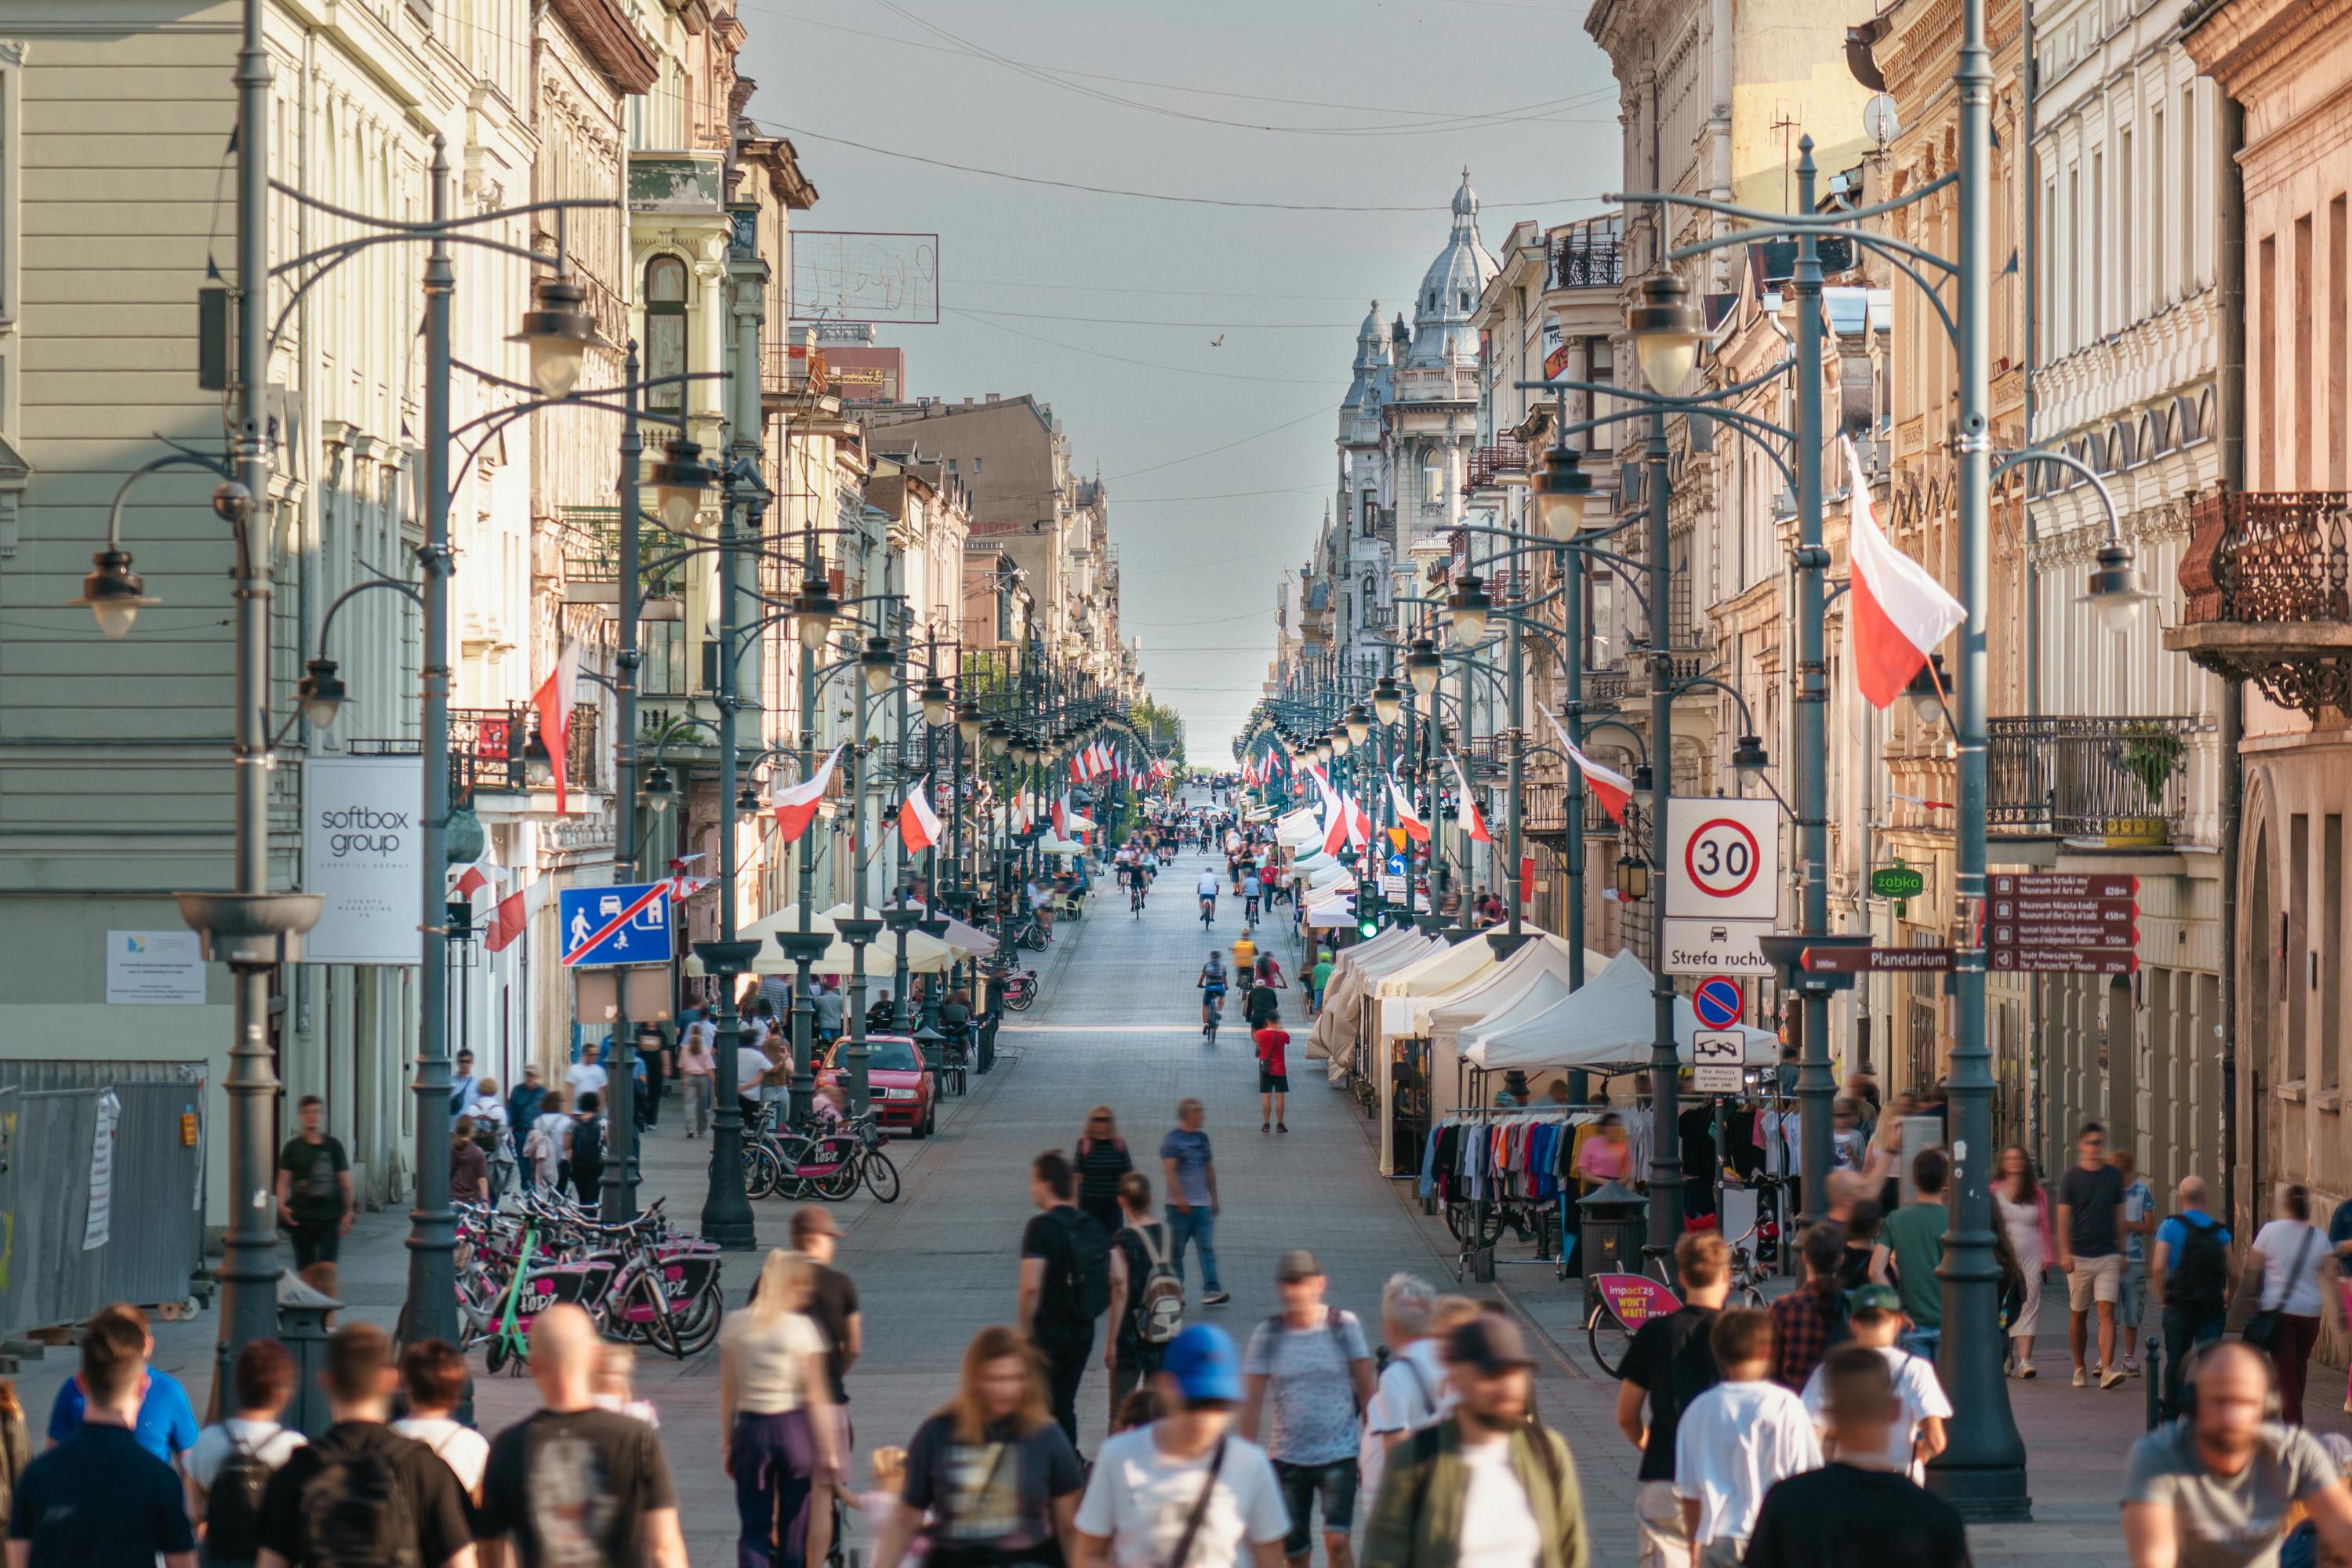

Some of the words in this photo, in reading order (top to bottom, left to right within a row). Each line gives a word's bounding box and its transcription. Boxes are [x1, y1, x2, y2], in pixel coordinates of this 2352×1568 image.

[321, 805, 408, 829] softbox
[331, 833, 400, 858] group
[1697, 840, 1748, 877] 30
[1878, 875, 1919, 888] żabka
[2020, 876, 2052, 884] Muzeum
[2053, 876, 2076, 884] Sztuki
[2020, 887, 2051, 895] Museum
[2053, 887, 2061, 895] of
[2061, 887, 2074, 895] Art
[2020, 901, 2051, 909] Muzeum
[2053, 901, 2077, 909] Miasta
[2020, 911, 2045, 920] Museum
[2045, 911, 2052, 920] of
[2053, 911, 2062, 920] the
[2063, 911, 2075, 921] City
[1671, 949, 1718, 966] Strefa
[1726, 951, 1767, 966] ruchu
[1871, 952, 1947, 967] Planetarium
[2039, 951, 2083, 961] Powszechny
[1618, 1298, 1647, 1308] WON'T
[1621, 1308, 1646, 1318] WAIT!
